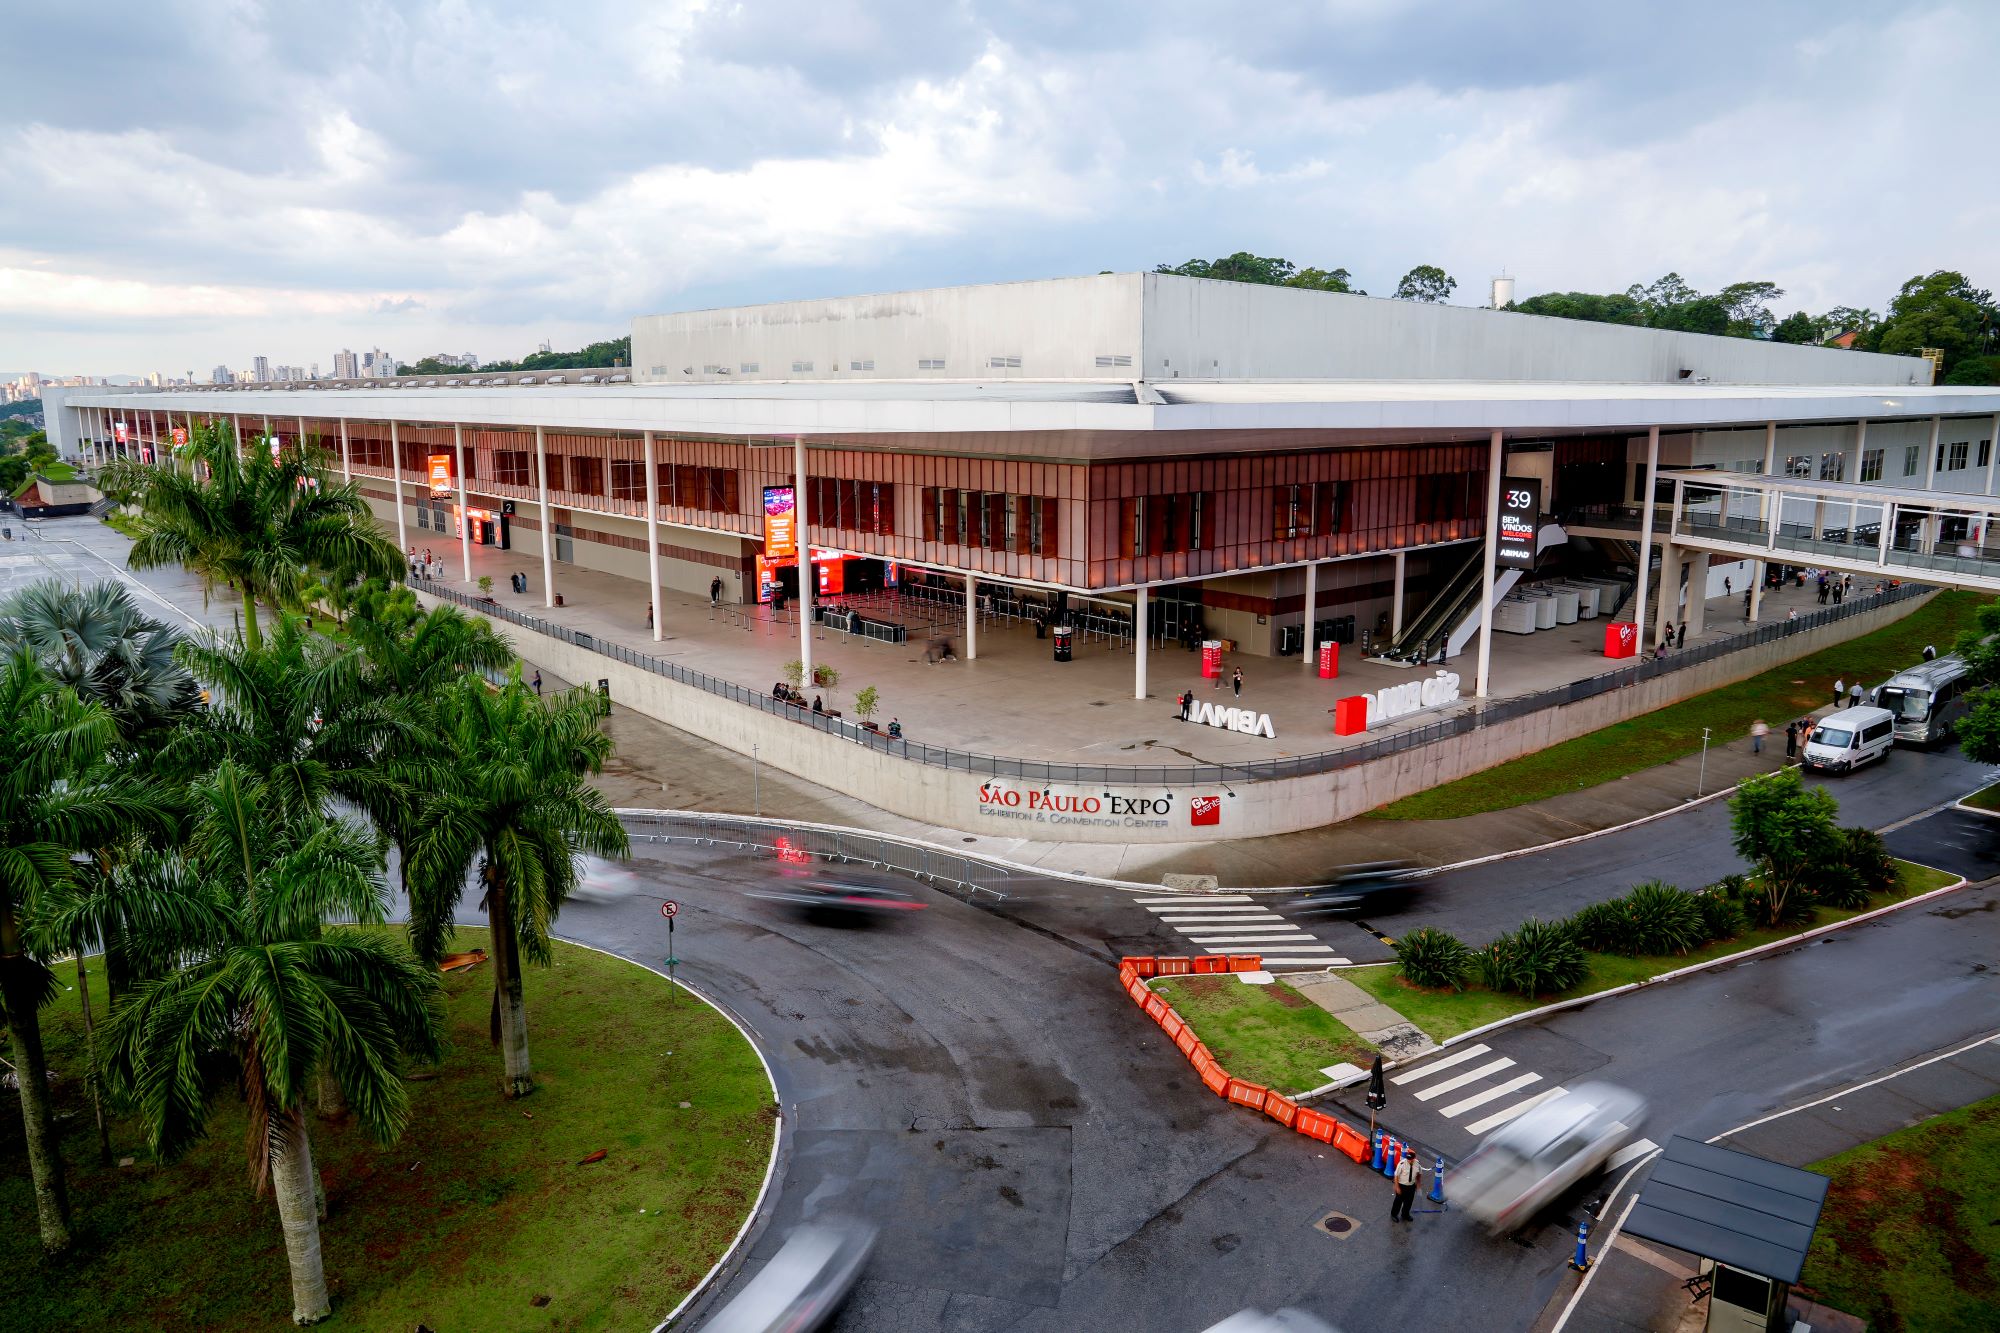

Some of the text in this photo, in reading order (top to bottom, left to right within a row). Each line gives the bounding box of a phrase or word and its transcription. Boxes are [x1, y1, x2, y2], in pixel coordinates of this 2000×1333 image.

[505, 503, 512, 513] 2
[1502, 515, 1519, 524] BEM
[1502, 524, 1532, 533] VINDOS
[1502, 531, 1532, 539] WELCOME
[1500, 549, 1530, 559] ABIMAD
[979, 784, 1170, 815] SÃO PAULO EXPO
[1192, 797, 1209, 809] GL
[1196, 798, 1220, 816] events
[979, 804, 1169, 828] EXHIBITION & CONVENTION CENTER
